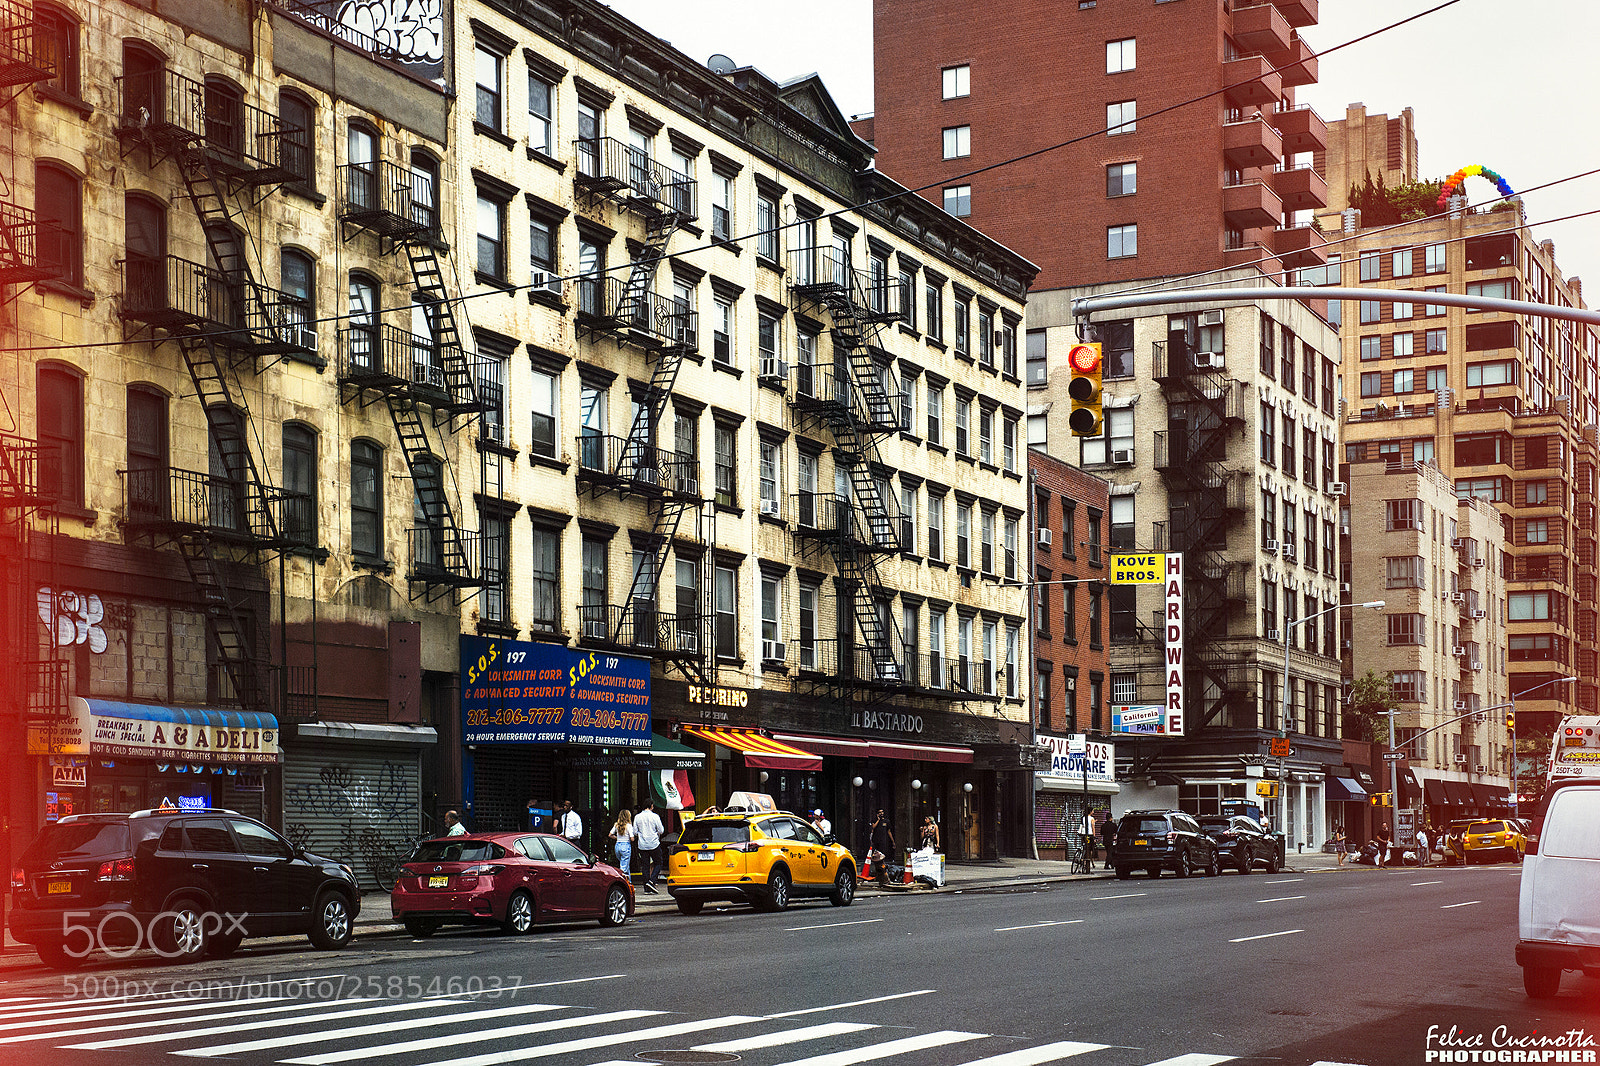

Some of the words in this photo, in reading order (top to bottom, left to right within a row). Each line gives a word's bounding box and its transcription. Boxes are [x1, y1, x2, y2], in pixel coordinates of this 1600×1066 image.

[1117, 556, 1156, 567] KOVE
[1116, 571, 1160, 581] BROS.
[1167, 558, 1182, 732] HARDWARE
[468, 643, 501, 684] S.O.S.
[507, 651, 526, 664] 197
[606, 657, 619, 669] 197
[489, 669, 536, 681] LOCKSMITH
[539, 669, 562, 680] CORP.
[569, 652, 599, 687] S.O.S.
[590, 674, 626, 688] LOCKSMITH
[628, 678, 646, 690] CORP.
[465, 688, 471, 699] &
[474, 687, 521, 698] ADVANCED
[523, 686, 566, 698] SECURITY
[570, 688, 576, 699] &
[578, 689, 615, 702] ADVANCED
[616, 693, 649, 705] SECURITY
[689, 685, 748, 708] PECORINO
[467, 707, 565, 726] 212-206-7777
[571, 707, 648, 731] 212-206-7777
[862, 711, 924, 734] BASTARDO
[1123, 709, 1159, 722] California
[97, 719, 134, 732] BREAKFAST
[137, 723, 143, 732] &
[1136, 724, 1164, 732] PAINTS
[95, 729, 116, 740] LUNCH
[120, 732, 147, 743] SPECIAL
[152, 725, 166, 744] A
[174, 726, 188, 745] &
[195, 729, 209, 748] A
[216, 730, 260, 750] DELI
[466, 733, 475, 741] 24
[476, 733, 495, 741] HOUR
[496, 732, 537, 741] EMERGENCY
[537, 732, 566, 741] SERVICE
[569, 734, 576, 742] 24
[578, 735, 594, 744] HOUR
[596, 735, 628, 746] EMERGENCY
[629, 738, 652, 747] SERVICE
[92, 744, 104, 753] HOT
[112, 746, 127, 755] COLD
[162, 750, 176, 759] BEER
[181, 751, 211, 761] CIGARETTES
[216, 753, 246, 762] NEWSPAPER
[251, 754, 276, 762] MAGAZINE
[1086, 743, 1109, 760] ROS.
[1053, 756, 1106, 774] ARDWARE
[1555, 766, 1583, 775] 25DT-120
[54, 767, 85, 781] ATM
